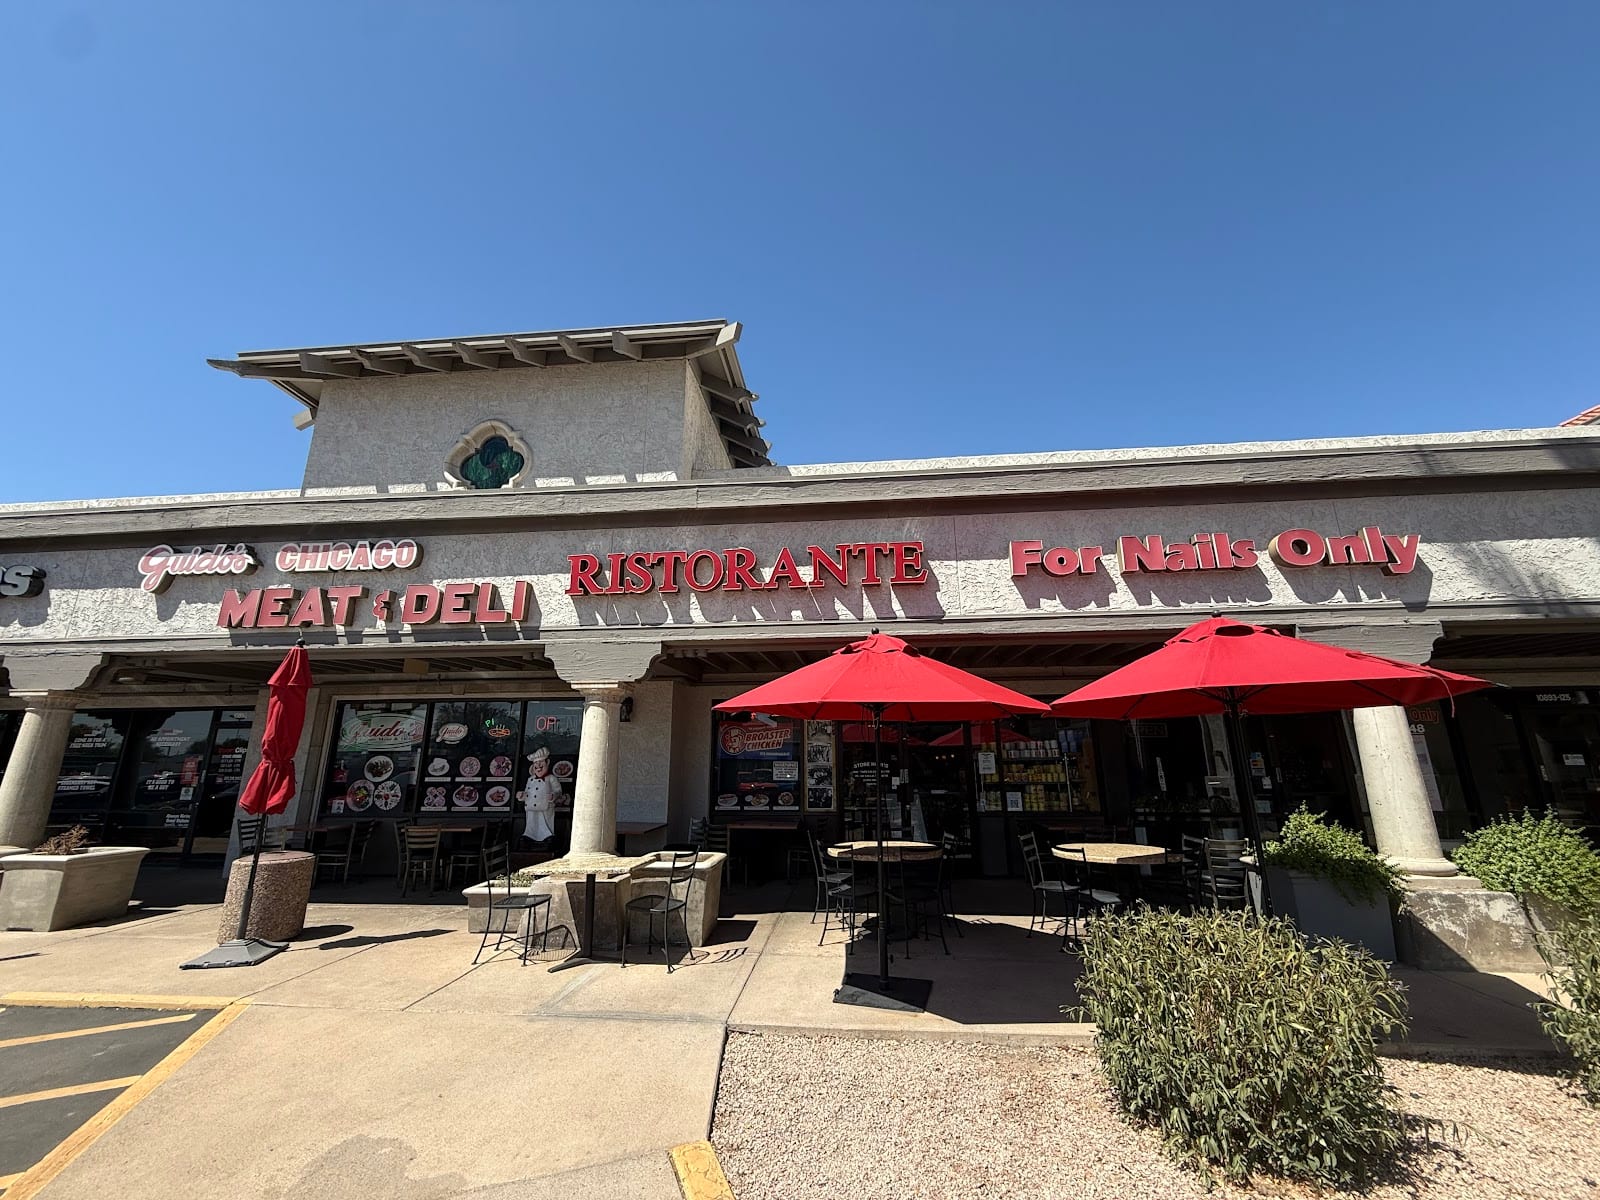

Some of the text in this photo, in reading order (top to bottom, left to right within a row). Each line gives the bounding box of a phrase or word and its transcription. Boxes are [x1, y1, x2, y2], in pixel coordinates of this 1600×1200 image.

[138, 539, 418, 592] Guido's CHICAGO
[565, 540, 928, 596] RISTORANTE
[1010, 526, 1421, 577] For Nails Only
[217, 580, 529, 628] MEAT & DELI
[746, 729, 790, 741] BROASTER
[746, 740, 782, 750] CHICKEN
[870, 761, 889, 769] HORS
